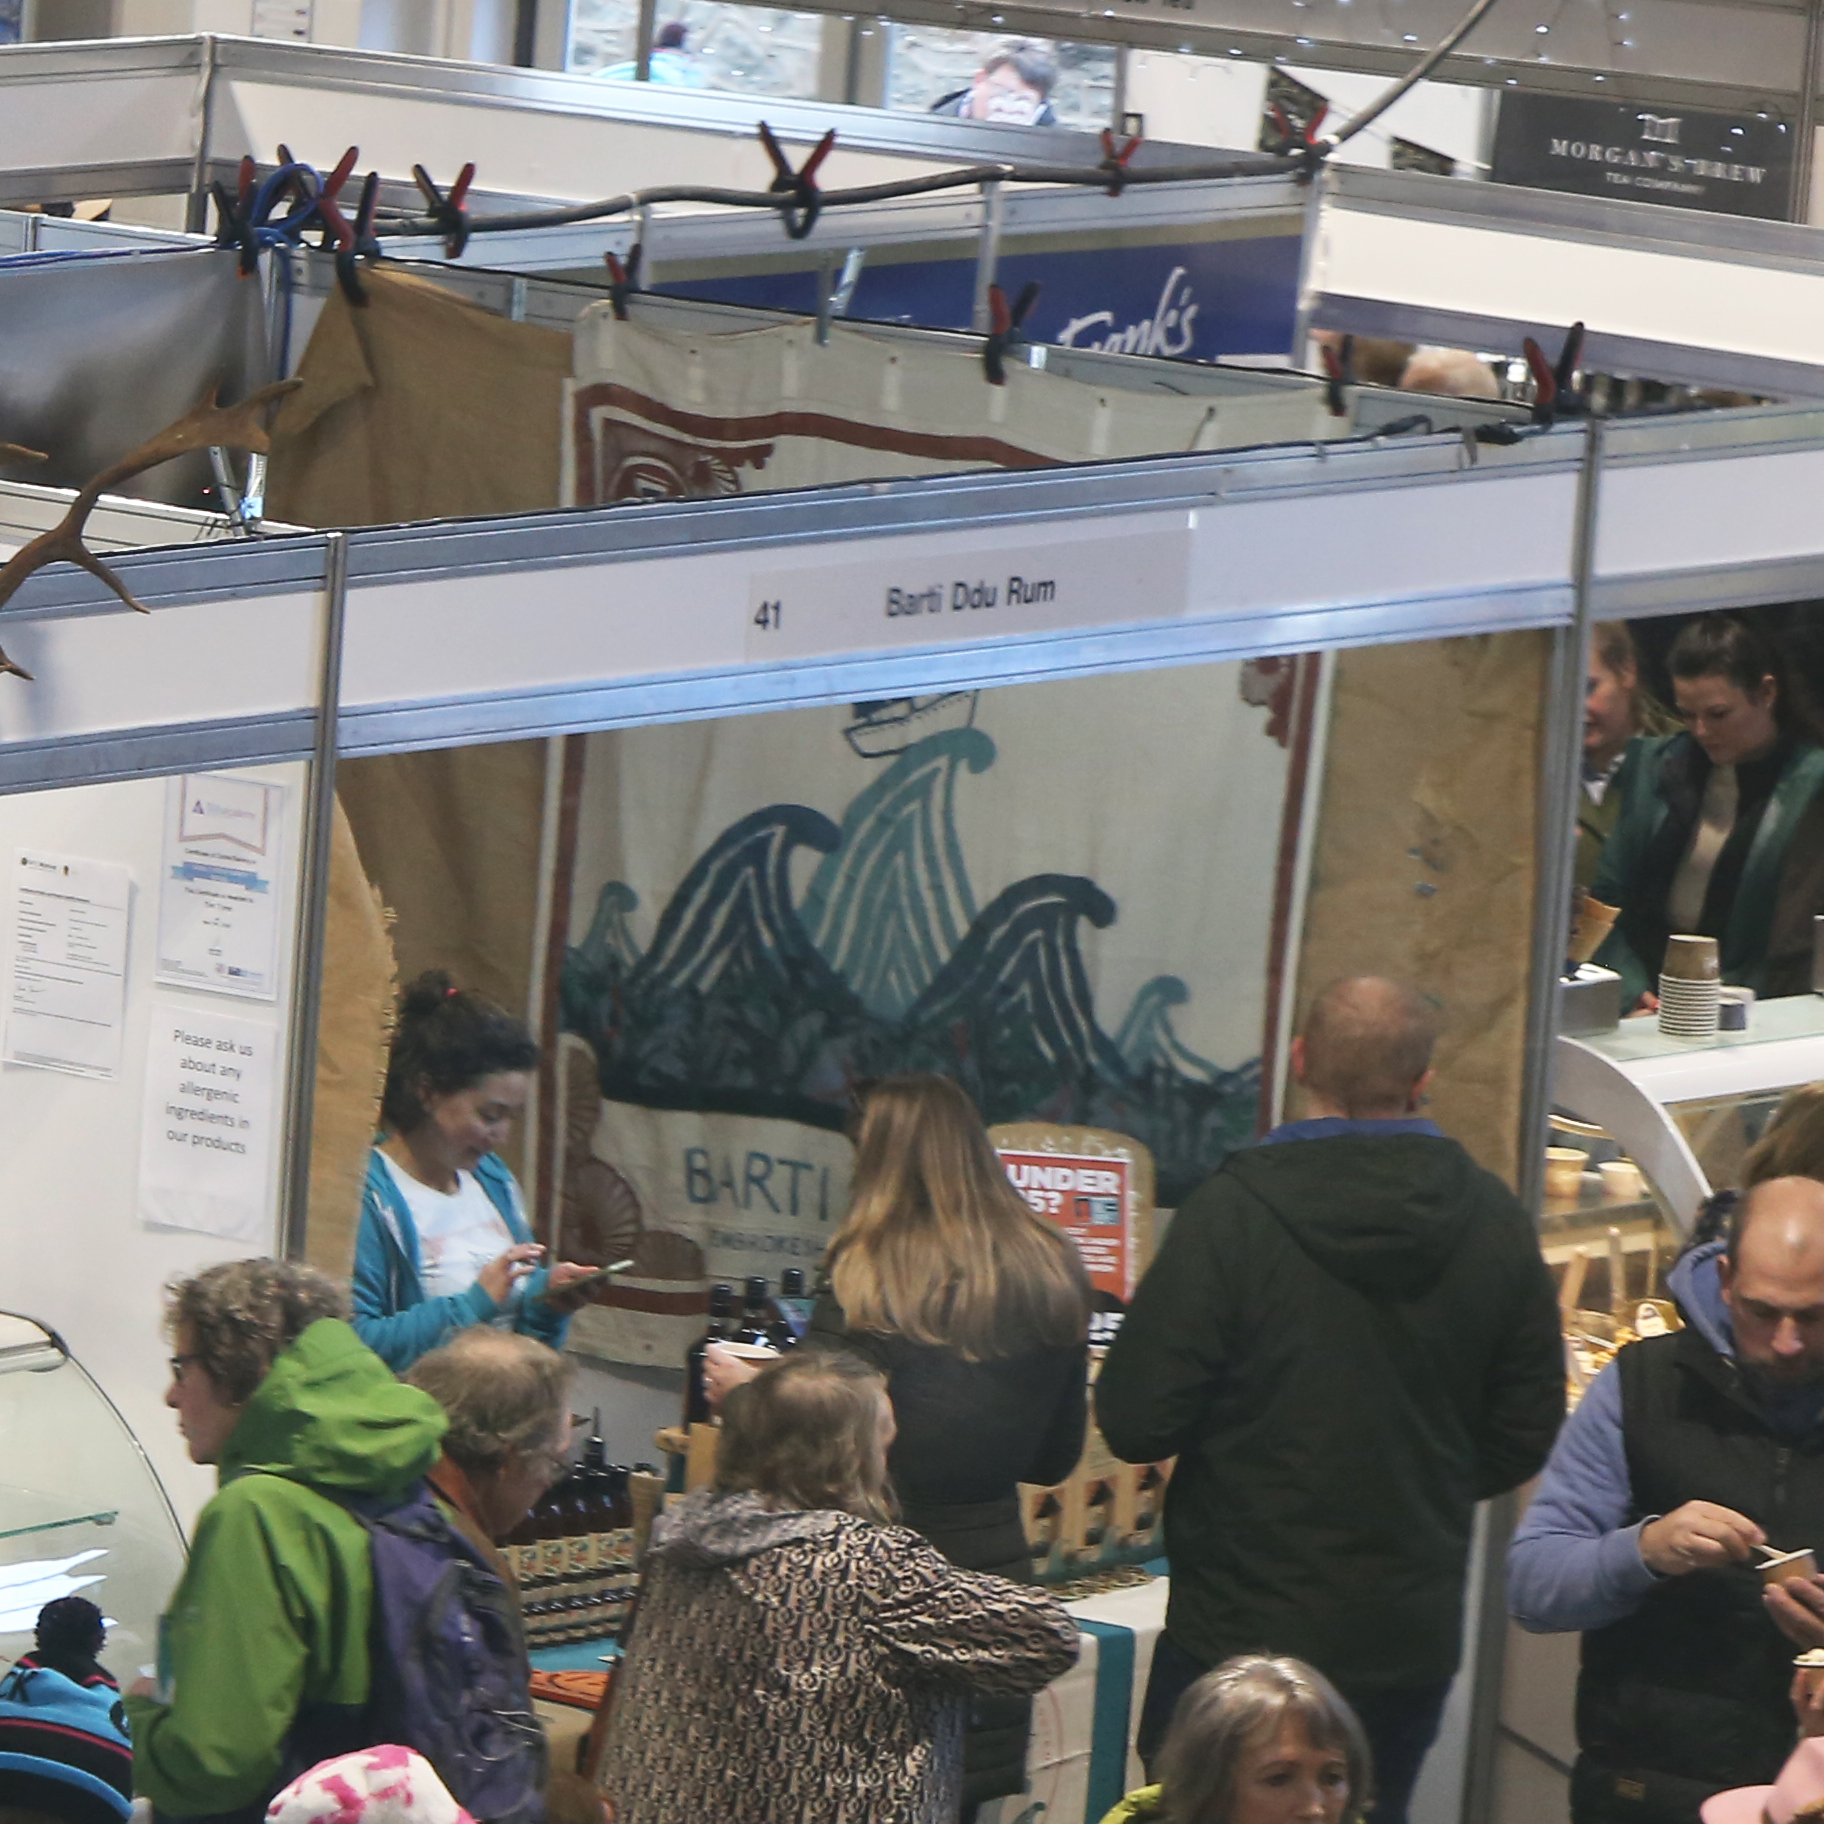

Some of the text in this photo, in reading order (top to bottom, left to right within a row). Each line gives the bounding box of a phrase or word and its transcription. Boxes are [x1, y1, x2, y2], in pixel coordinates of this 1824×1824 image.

[753, 575, 1056, 631] 41 Barti Ddu Rum
[173, 1029, 254, 1057] Please ask us
[180, 1056, 242, 1081] about any
[179, 1080, 240, 1104] allergenic
[165, 1102, 250, 1129] ingredients in
[166, 1129, 247, 1155] our products
[684, 1146, 830, 1222] BARTI
[1006, 1162, 1121, 1195] UNDER
